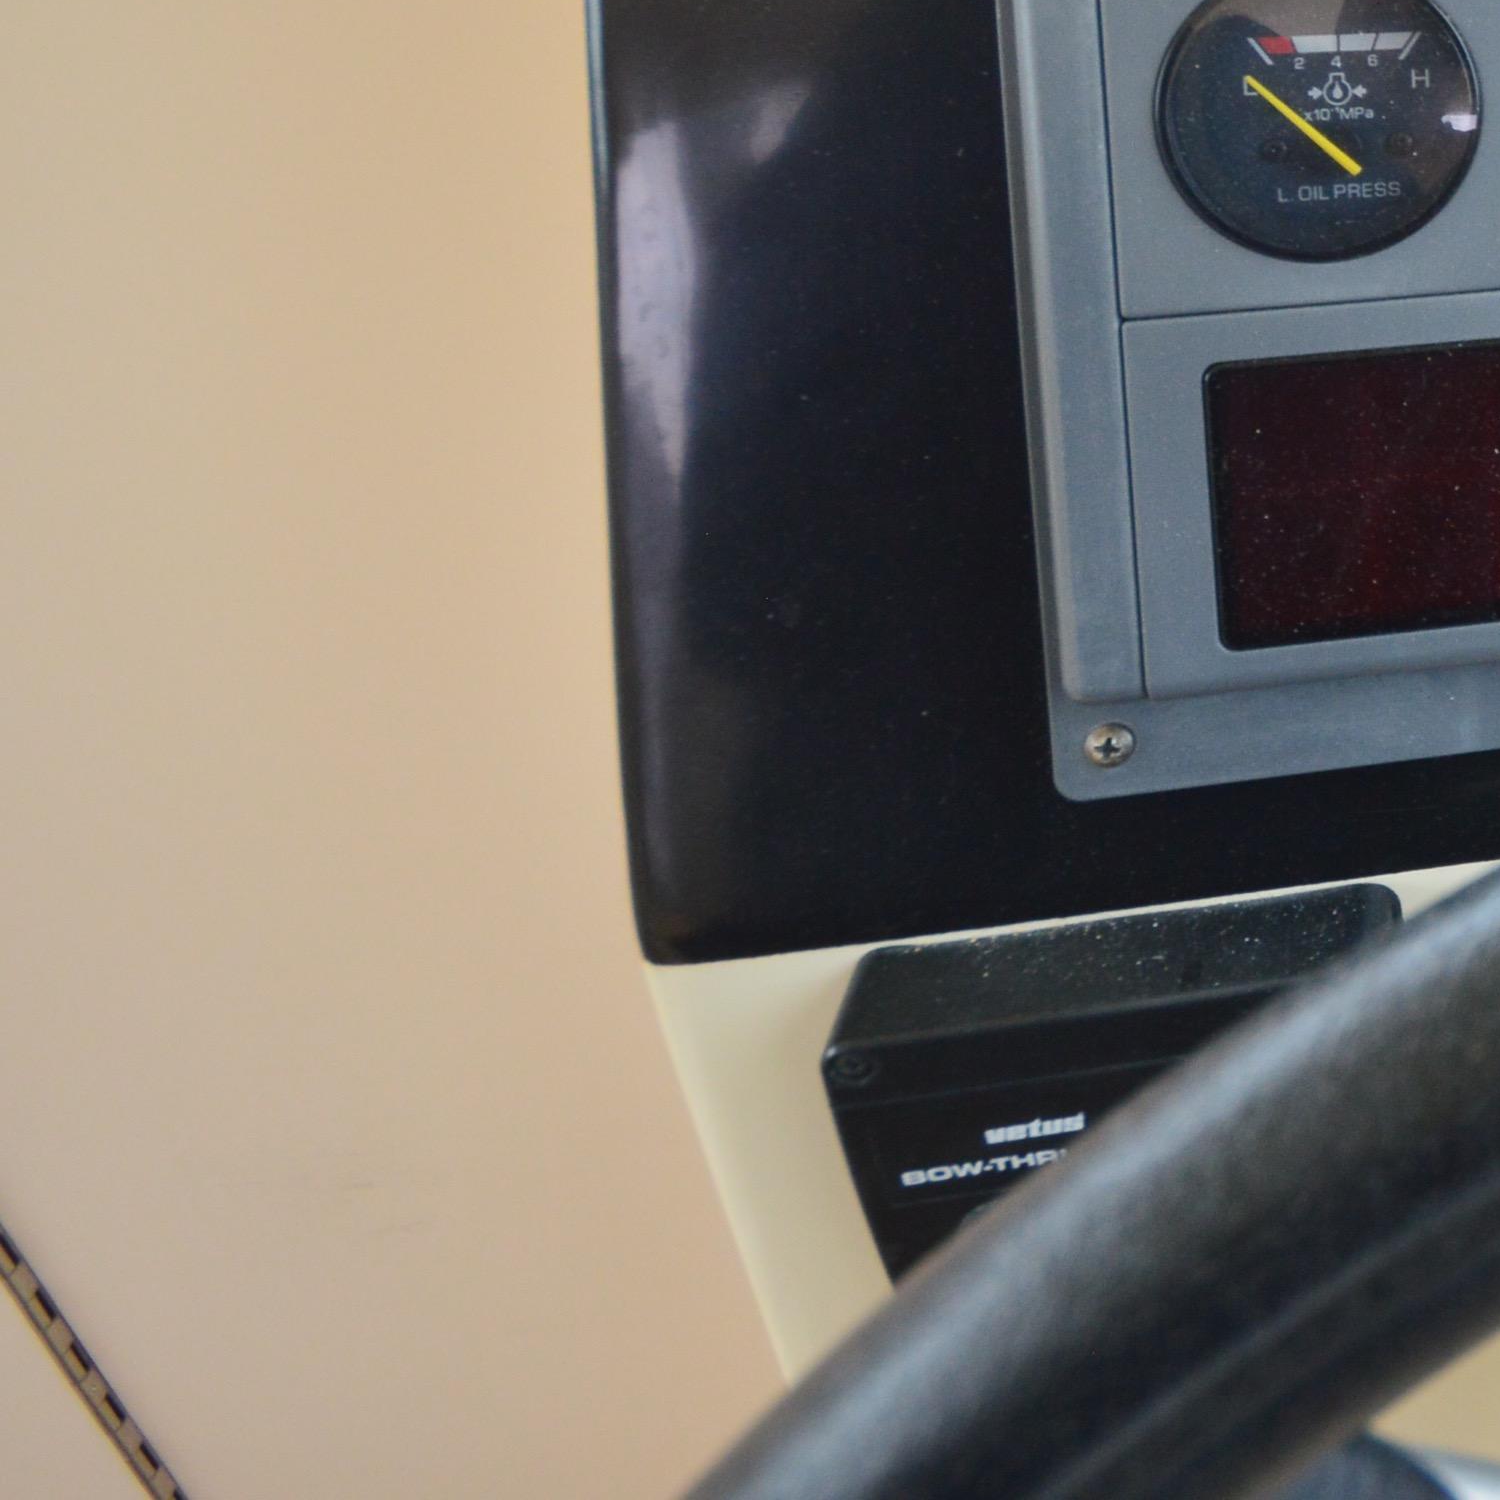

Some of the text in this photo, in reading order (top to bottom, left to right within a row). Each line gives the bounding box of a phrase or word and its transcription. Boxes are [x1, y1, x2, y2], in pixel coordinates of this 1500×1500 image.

[1292, 54, 1379, 70] 2 4 6
[1410, 67, 1431, 89] H
[1333, 181, 1402, 198] PRESS
[984, 1111, 1086, 1145] vetus
[900, 1148, 1067, 1187] BOW-THR
